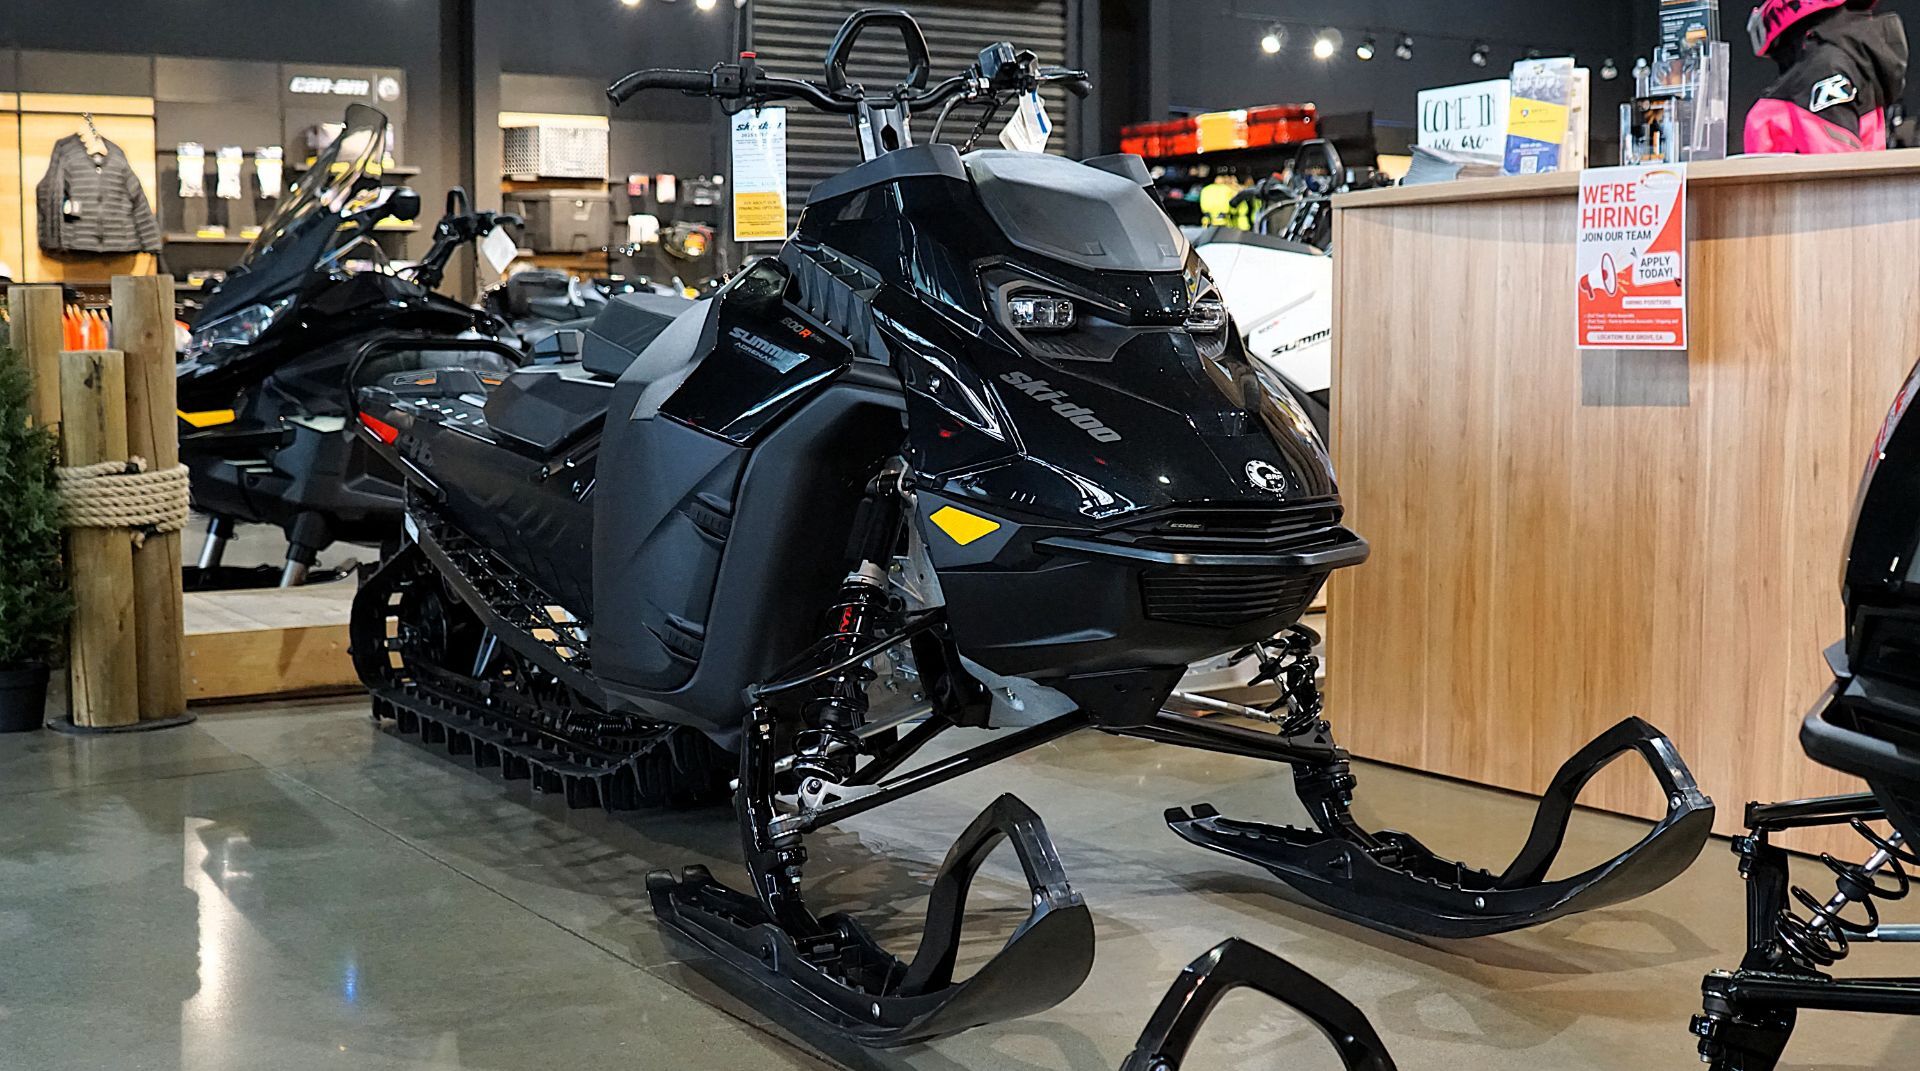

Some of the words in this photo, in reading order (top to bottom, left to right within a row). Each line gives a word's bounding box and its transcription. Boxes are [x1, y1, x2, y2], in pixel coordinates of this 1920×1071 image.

[1423, 96, 1472, 133] COME
[1478, 93, 1496, 128] IN
[1583, 183, 1637, 205] WE'RE
[1583, 204, 1659, 229] HIRING!
[1582, 233, 1603, 242] JOIN
[1605, 232, 1623, 240] OUR
[1626, 230, 1652, 240] TEAM
[1639, 268, 1673, 279] TODAY!
[1640, 257, 1671, 267] APPLY
[1271, 328, 1331, 358] SUMMI
[999, 371, 1122, 443] ski-doo
